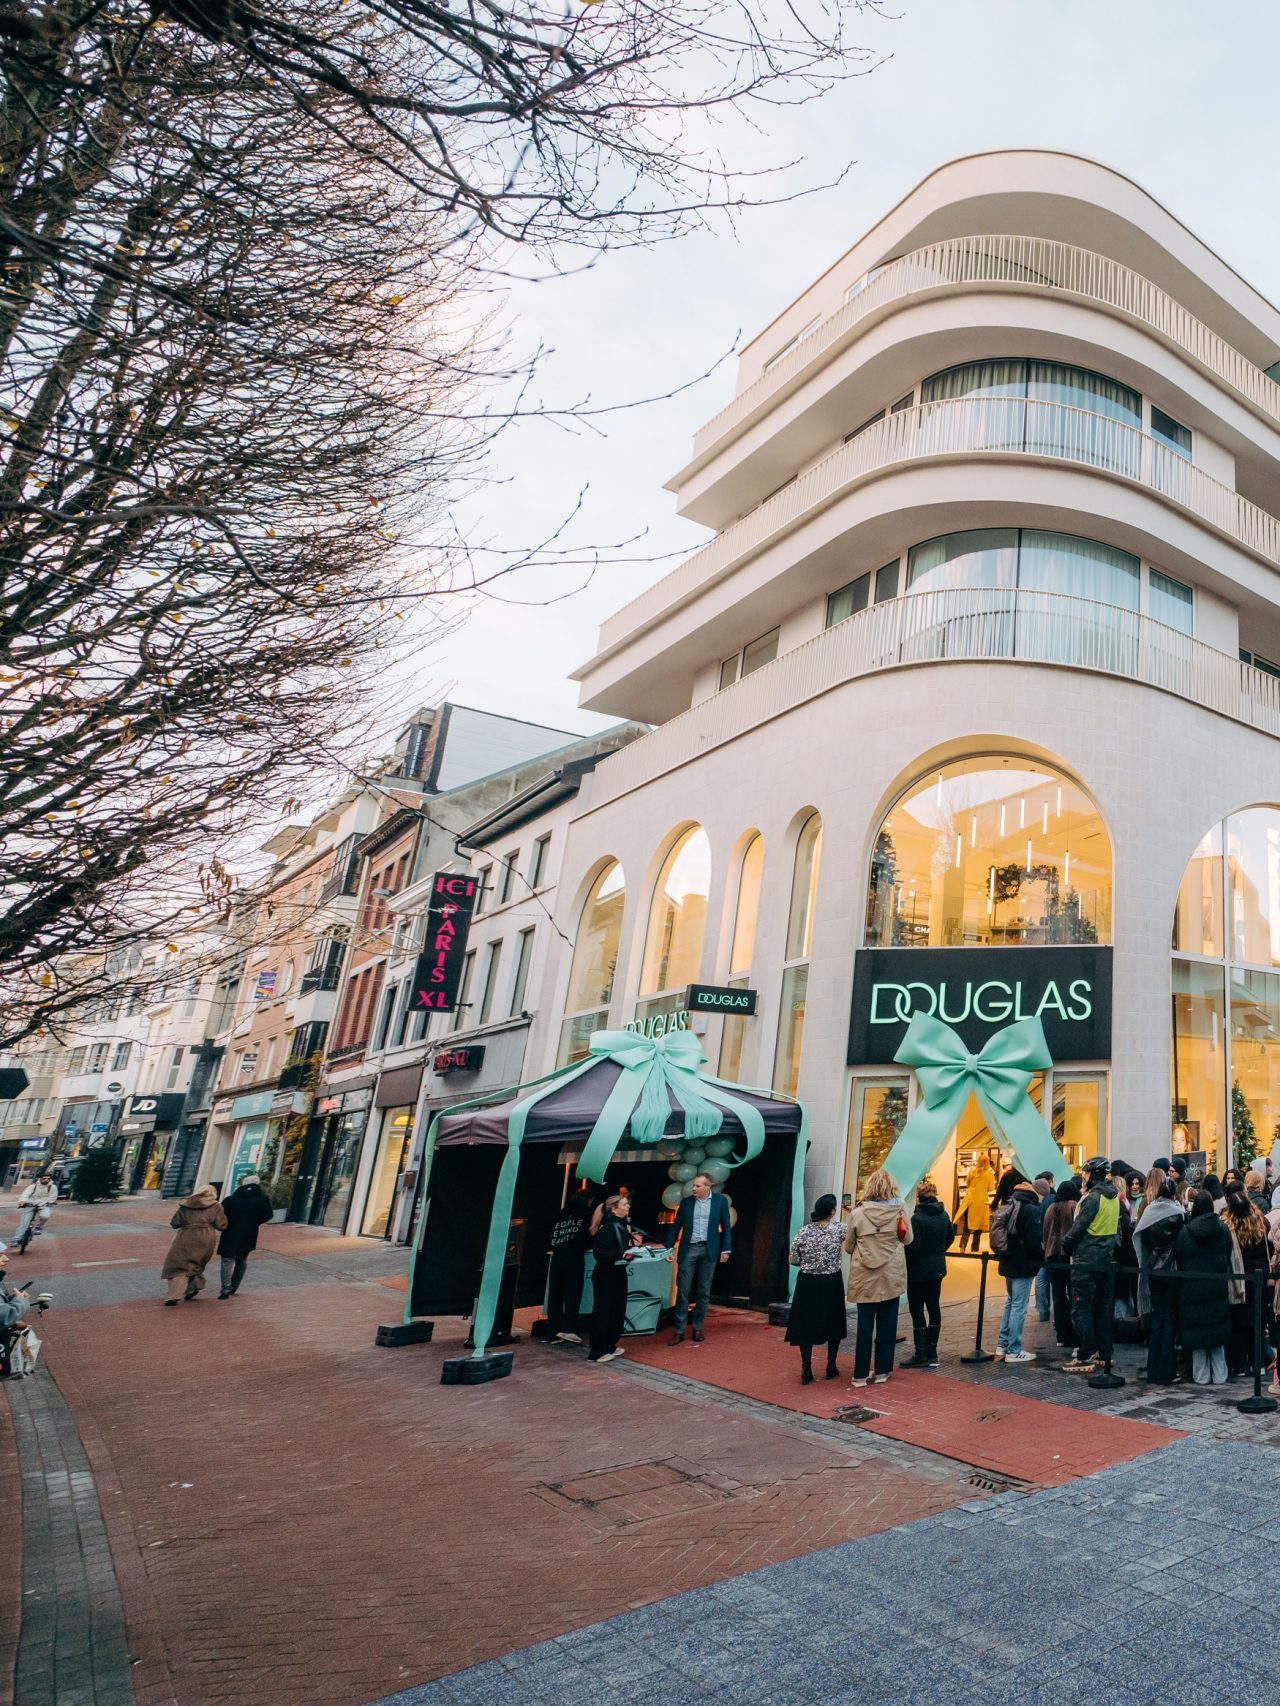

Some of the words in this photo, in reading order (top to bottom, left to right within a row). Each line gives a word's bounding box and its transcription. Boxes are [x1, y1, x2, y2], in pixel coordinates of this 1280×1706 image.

[436, 877, 474, 897] ICI
[431, 903, 458, 983] PARIS
[416, 990, 449, 1008] XL
[698, 992, 749, 1007] DOUGLAS
[870, 979, 1092, 1024] DOUGLAS
[132, 1099, 157, 1111] JD
[553, 1226, 579, 1238] EHIND
[555, 1219, 583, 1229] EOPLE
